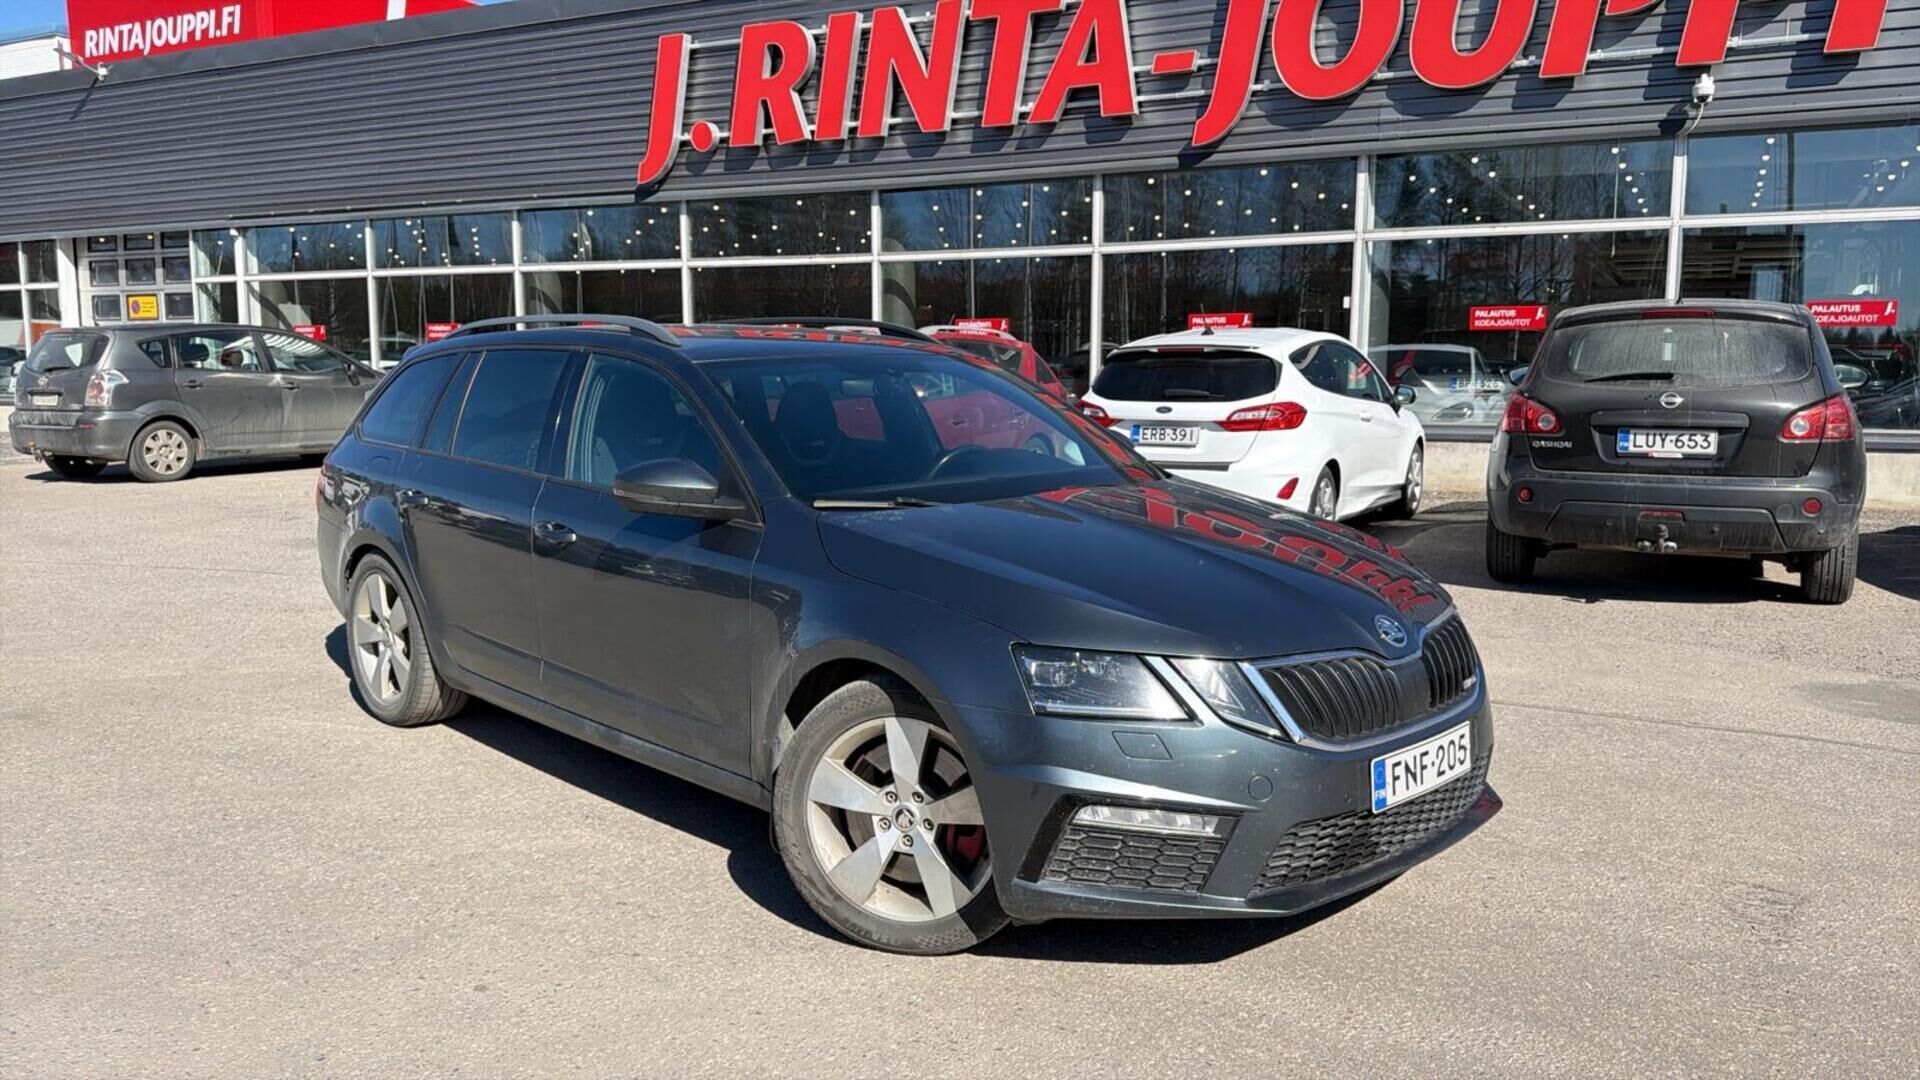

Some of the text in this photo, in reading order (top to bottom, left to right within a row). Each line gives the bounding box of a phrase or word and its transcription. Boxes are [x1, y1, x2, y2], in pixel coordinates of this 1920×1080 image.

[85, 4, 241, 58] RINTAJOUPPI.FI
[637, 0, 1888, 184] J.RINTA-JOU
[1475, 310, 1516, 318] PALAUTUS
[1811, 304, 1861, 312] PALAUTUS
[1632, 432, 1712, 449] LUY-653
[1391, 733, 1468, 796] FNF-205
